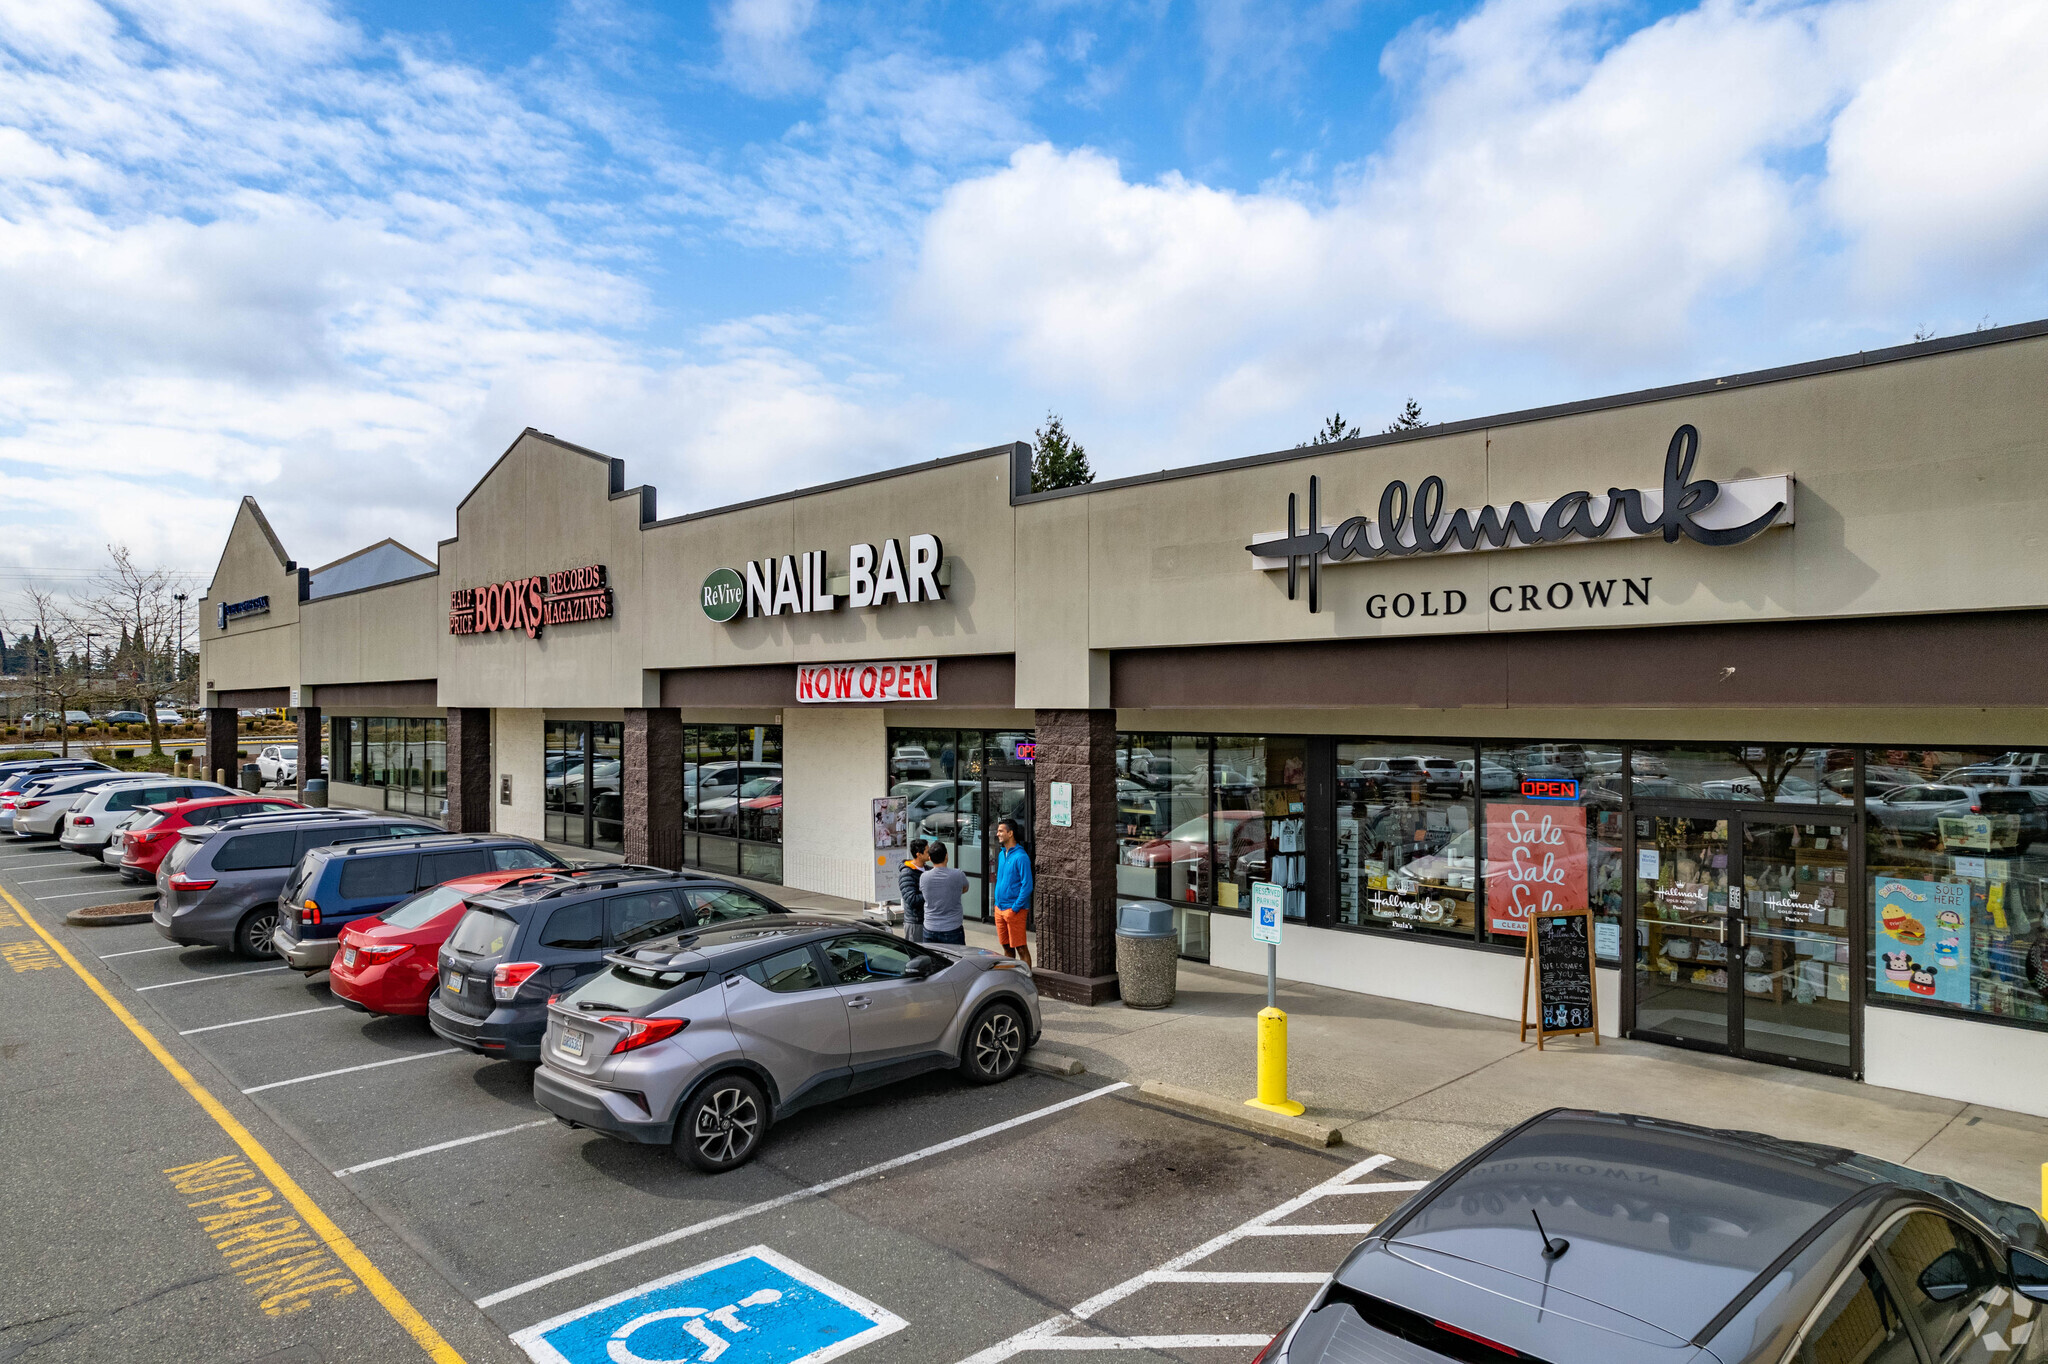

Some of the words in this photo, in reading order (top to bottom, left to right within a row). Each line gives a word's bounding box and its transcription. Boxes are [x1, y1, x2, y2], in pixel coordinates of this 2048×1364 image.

[1245, 424, 1786, 614] Hallmark
[549, 565, 600, 594] RECORDS
[746, 550, 834, 618] NAIL
[850, 533, 943, 608] BAR
[451, 589, 471, 609] HALF
[703, 582, 742, 607] RéVive
[1366, 590, 1467, 619] GOLD
[1489, 577, 1653, 613] CROWN
[475, 576, 543, 639] BOOKS
[543, 595, 607, 625] MAGAZINES
[449, 615, 473, 634] PRICE
[800, 667, 855, 699] NOW
[859, 664, 933, 698] OPEN
[1521, 782, 1575, 797] OPEN
[1732, 784, 1750, 794] 105
[1507, 809, 1565, 846] Sale
[1508, 846, 1565, 886] Sale
[1255, 886, 1281, 898] RESERVED
[1256, 896, 1279, 907] PARKING
[1367, 890, 1438, 914] Hallmark
[1653, 885, 1708, 900] Hallmark
[1936, 885, 1963, 896] SOLD
[1763, 895, 1826, 912] Hallmark
[1392, 921, 1413, 929] Paula's
[163, 1154, 256, 1195] NO
[187, 1186, 358, 1317] PARKING
